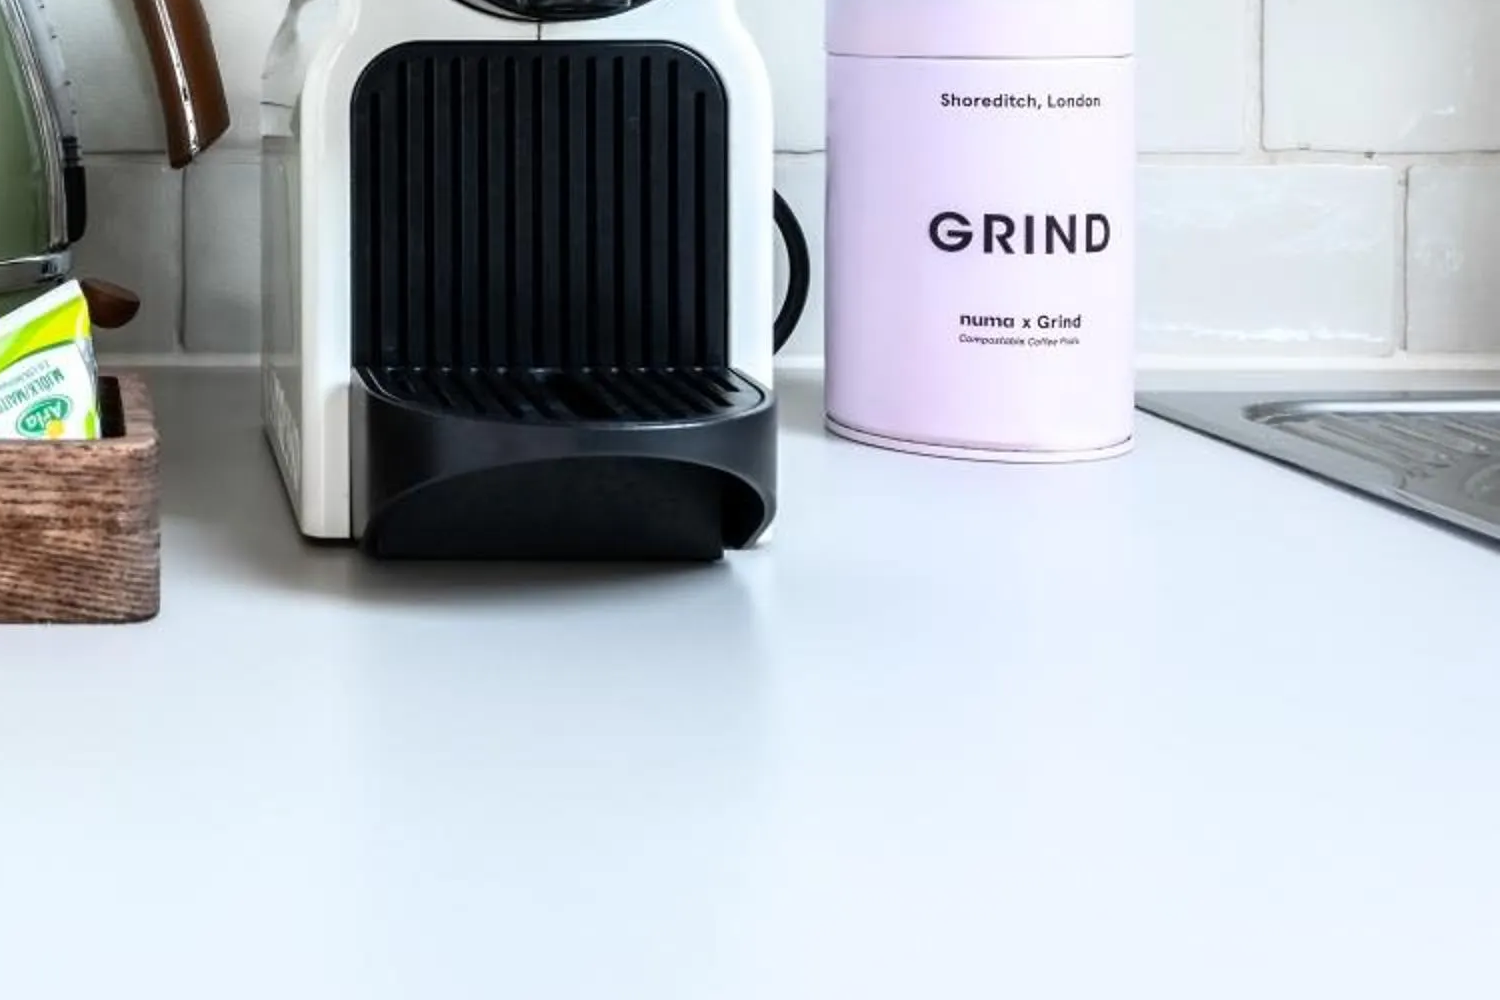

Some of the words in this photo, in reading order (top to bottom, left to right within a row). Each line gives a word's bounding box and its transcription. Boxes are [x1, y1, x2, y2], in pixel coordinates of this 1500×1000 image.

[941, 93, 1042, 110] Shoreditch,
[1047, 94, 1101, 108] London
[929, 211, 1111, 254] GRIND
[959, 314, 1015, 328] numa
[1022, 318, 1031, 328] x
[1037, 314, 1082, 328] Grind
[25, 401, 63, 430] Arla
